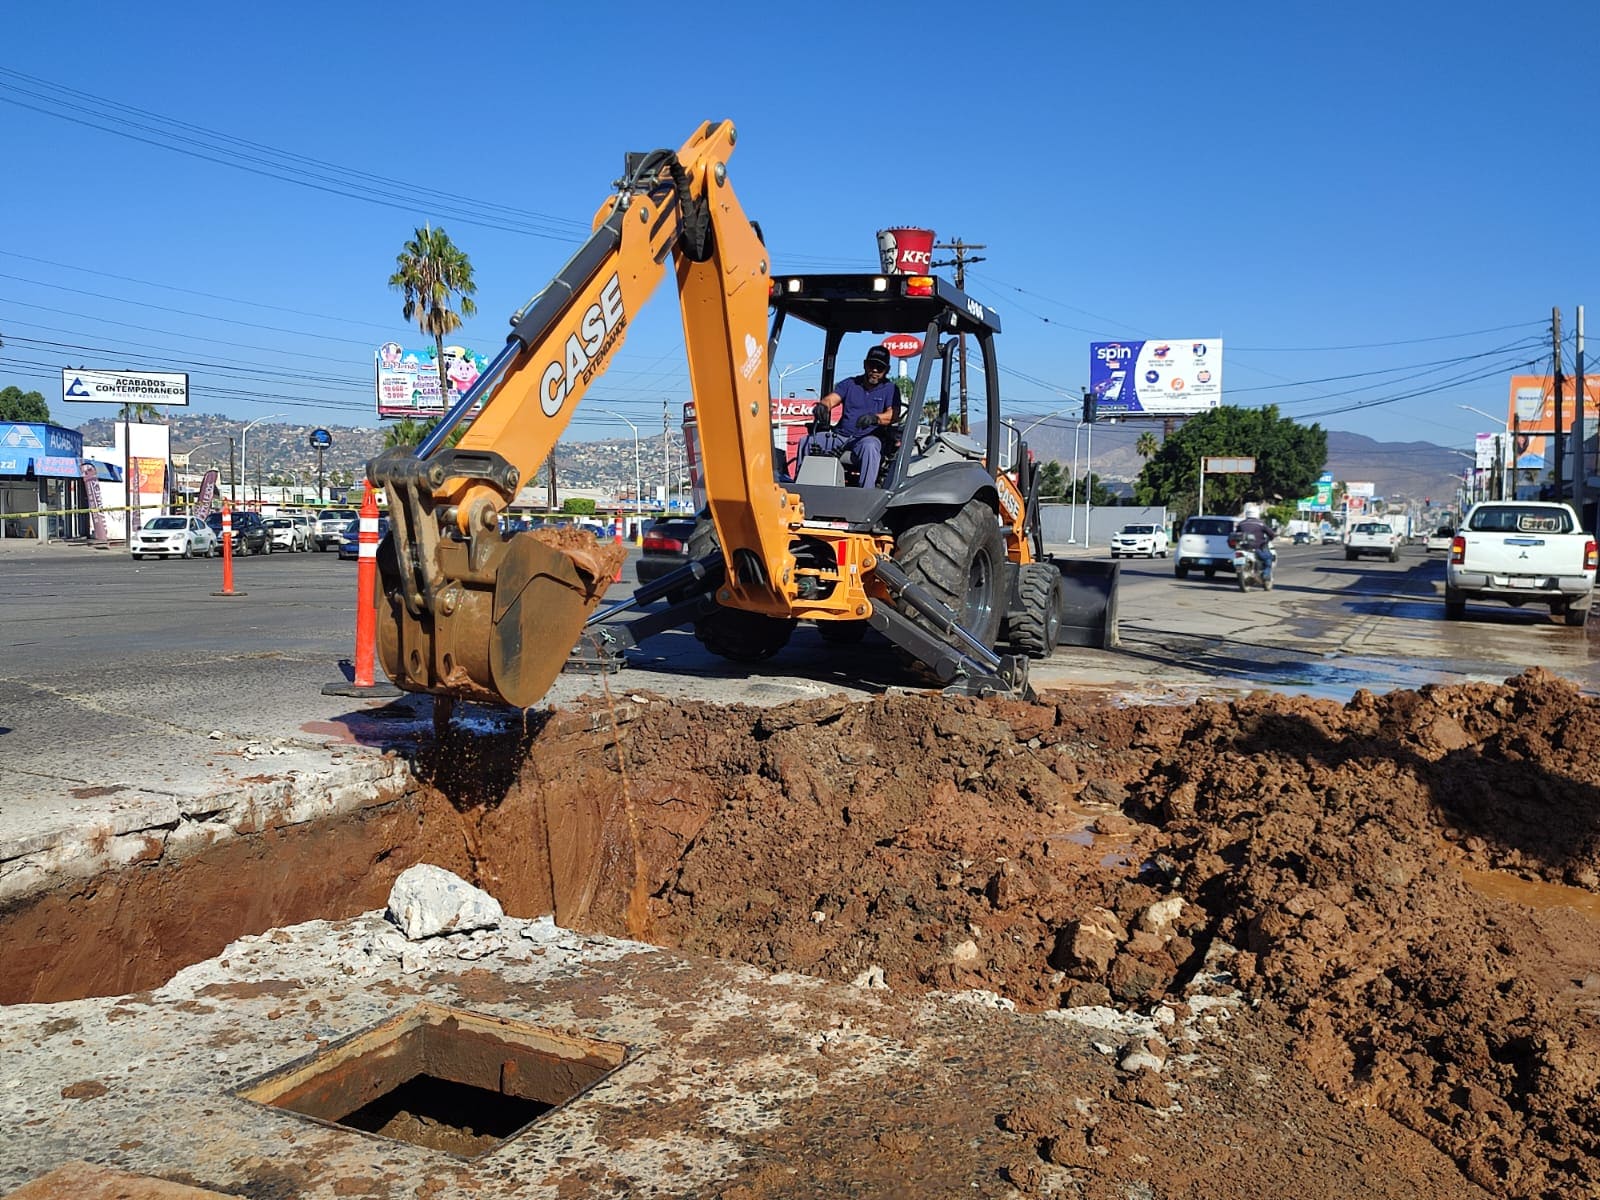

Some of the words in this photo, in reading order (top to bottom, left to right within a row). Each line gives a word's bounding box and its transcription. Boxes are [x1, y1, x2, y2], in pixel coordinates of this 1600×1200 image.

[902, 250, 931, 265] KFC
[540, 270, 624, 418] CASE
[582, 314, 628, 386] EXTENDAHOE
[1097, 345, 1131, 362] spin
[96, 385, 185, 394] CONTEMPORANEOS
[116, 379, 166, 387] ACABADOS
[997, 479, 1020, 519] CASE
